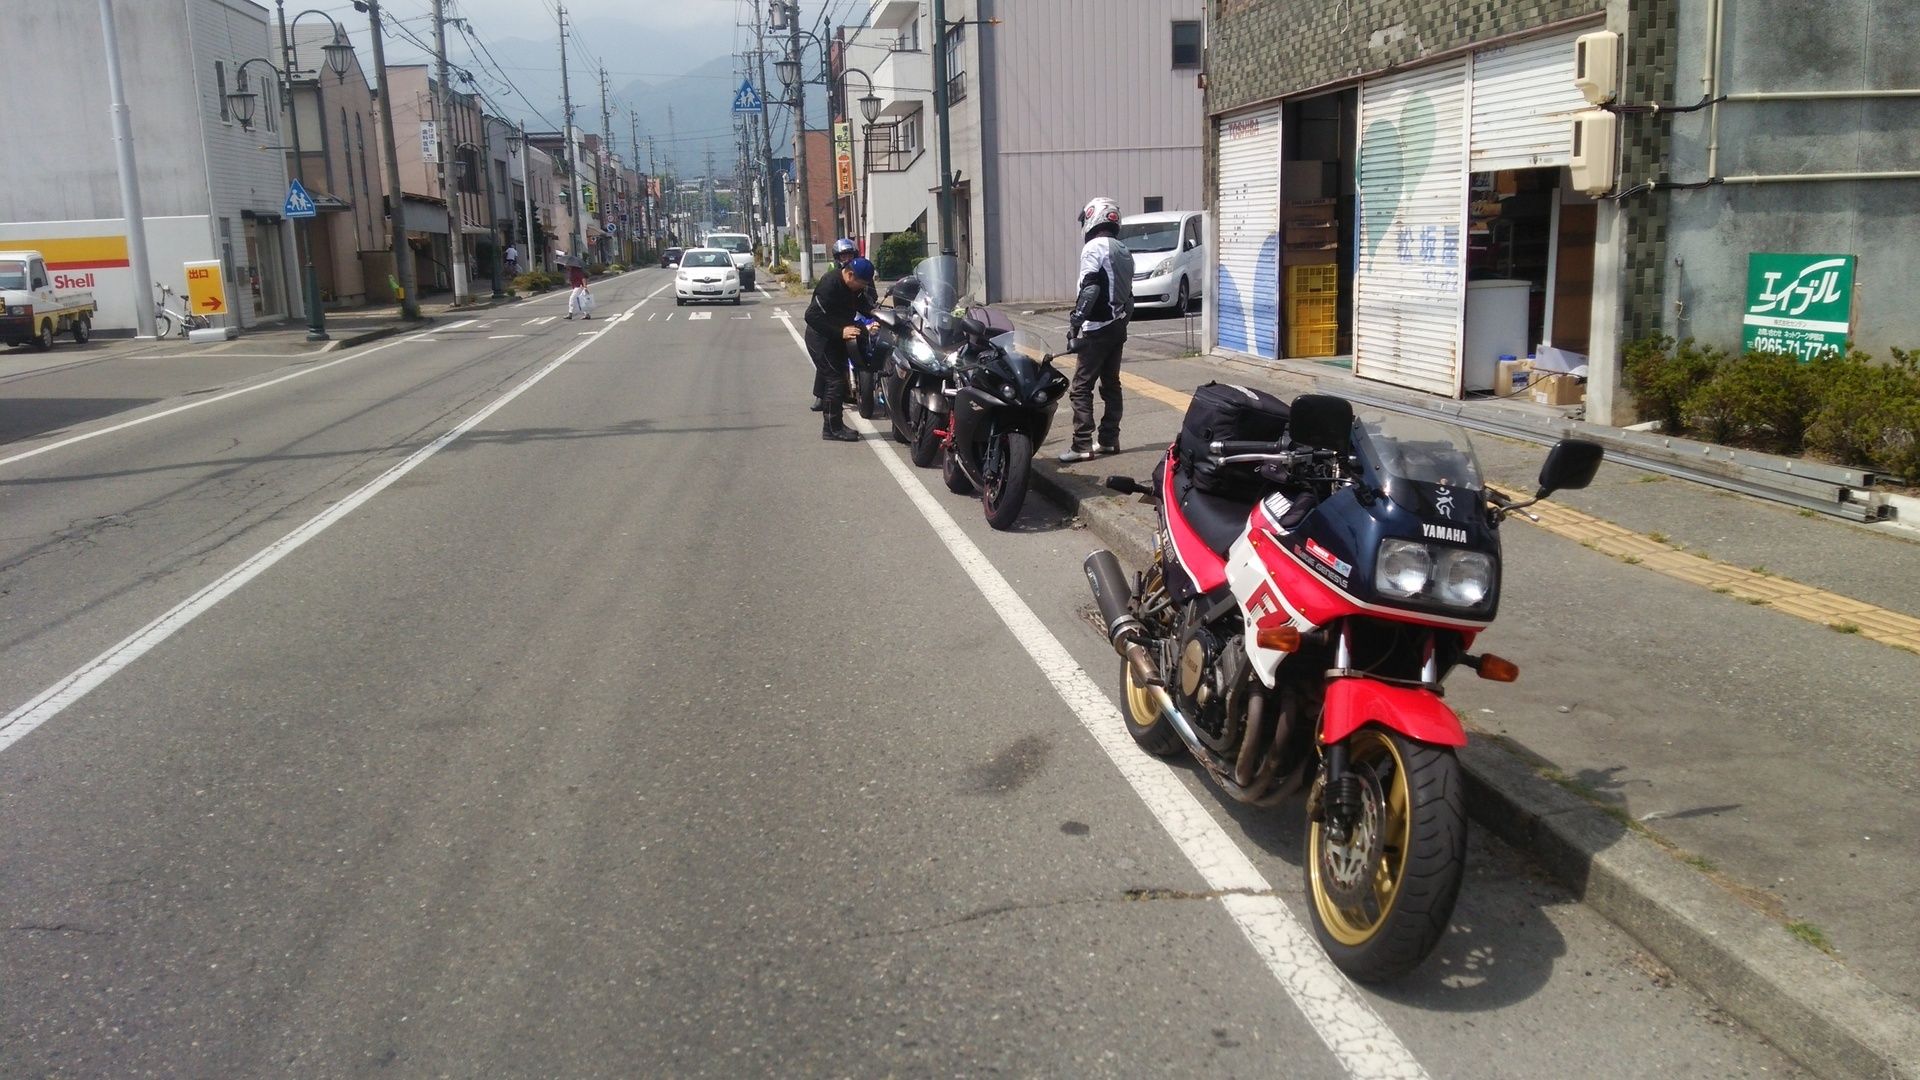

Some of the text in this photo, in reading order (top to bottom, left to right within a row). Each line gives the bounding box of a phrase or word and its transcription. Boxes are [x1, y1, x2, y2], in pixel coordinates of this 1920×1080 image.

[1229, 119, 1260, 139] TOSHIBA
[54, 273, 95, 289] Shell
[188, 269, 209, 279] 出口
[1751, 258, 1846, 315] エイブル
[1422, 523, 1467, 544] YAMAHA
